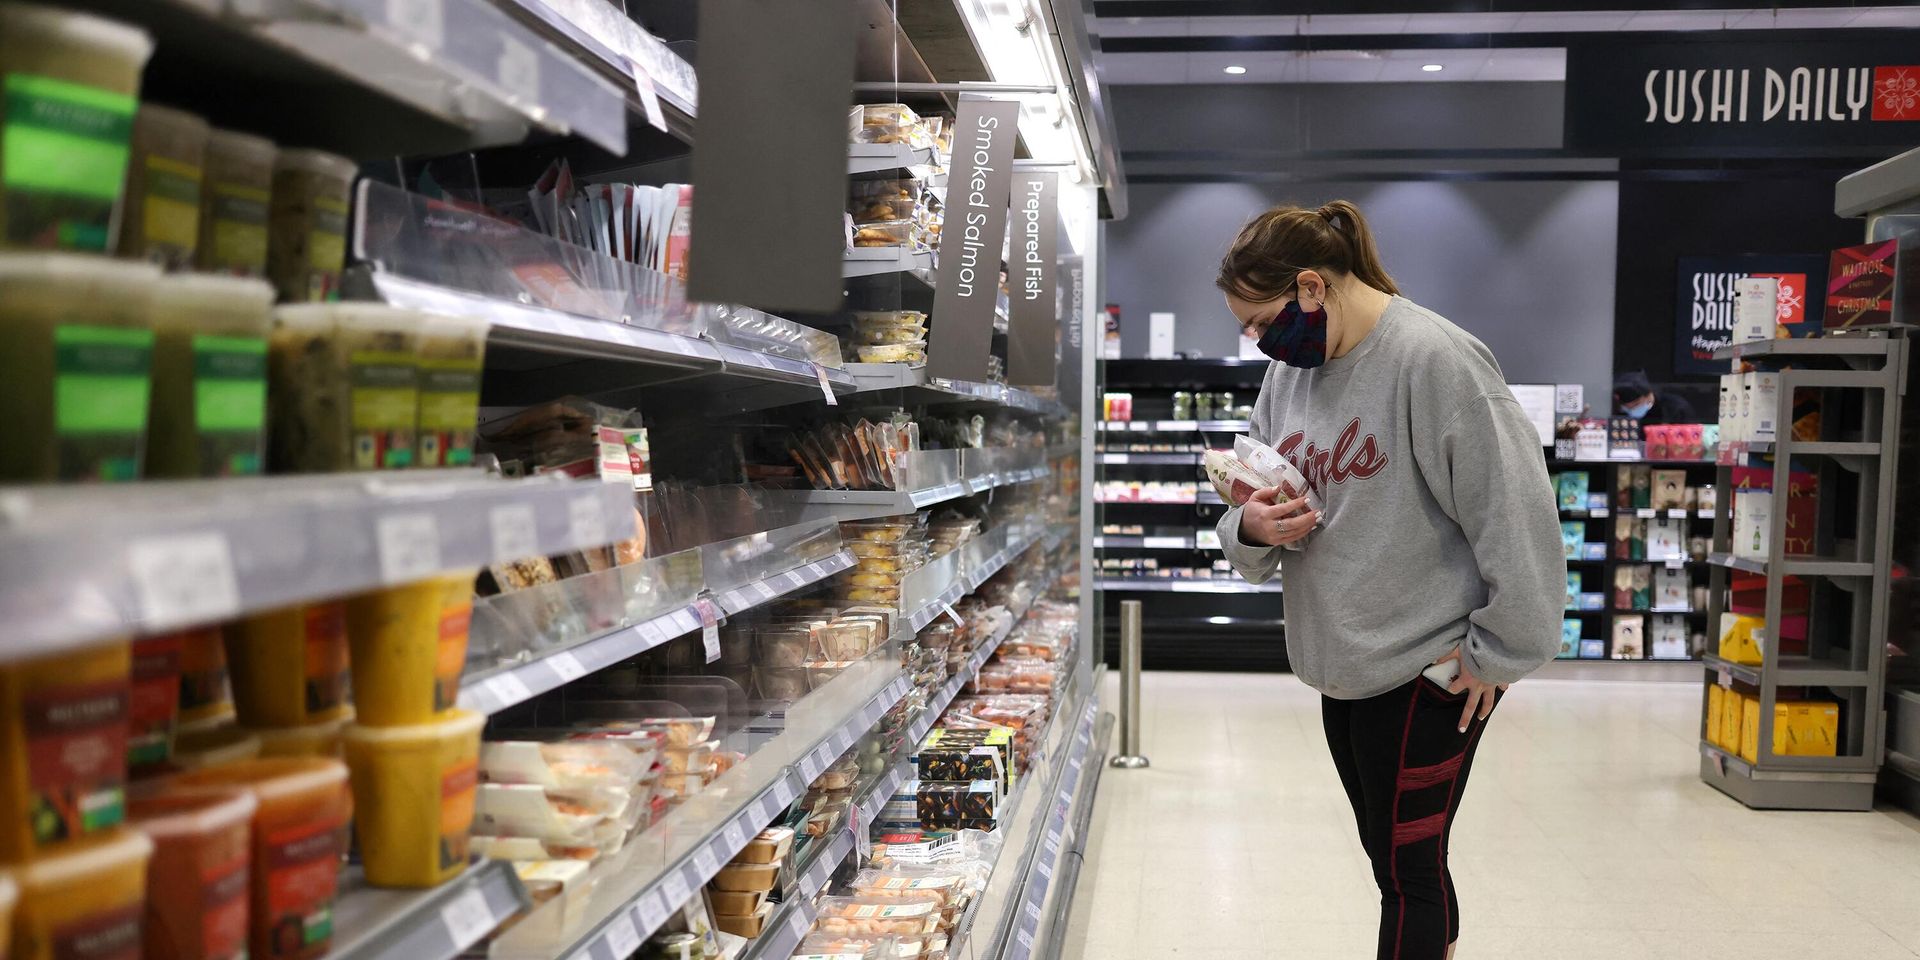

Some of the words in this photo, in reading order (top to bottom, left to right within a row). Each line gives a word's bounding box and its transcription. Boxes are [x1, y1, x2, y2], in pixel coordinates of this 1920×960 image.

[1644, 69, 1750, 124] SUSHI
[1762, 66, 1870, 122] DAILY
[968, 115, 998, 208] Smoked
[1022, 180, 1044, 263] Prepared
[957, 212, 987, 298] Salmon
[1842, 259, 1884, 278] WAITROSE
[1025, 266, 1043, 300] Fish
[1692, 272, 1748, 301] SUSH
[1692, 301, 1734, 330] DAIL
[1837, 296, 1880, 314] CHRISTMAS
